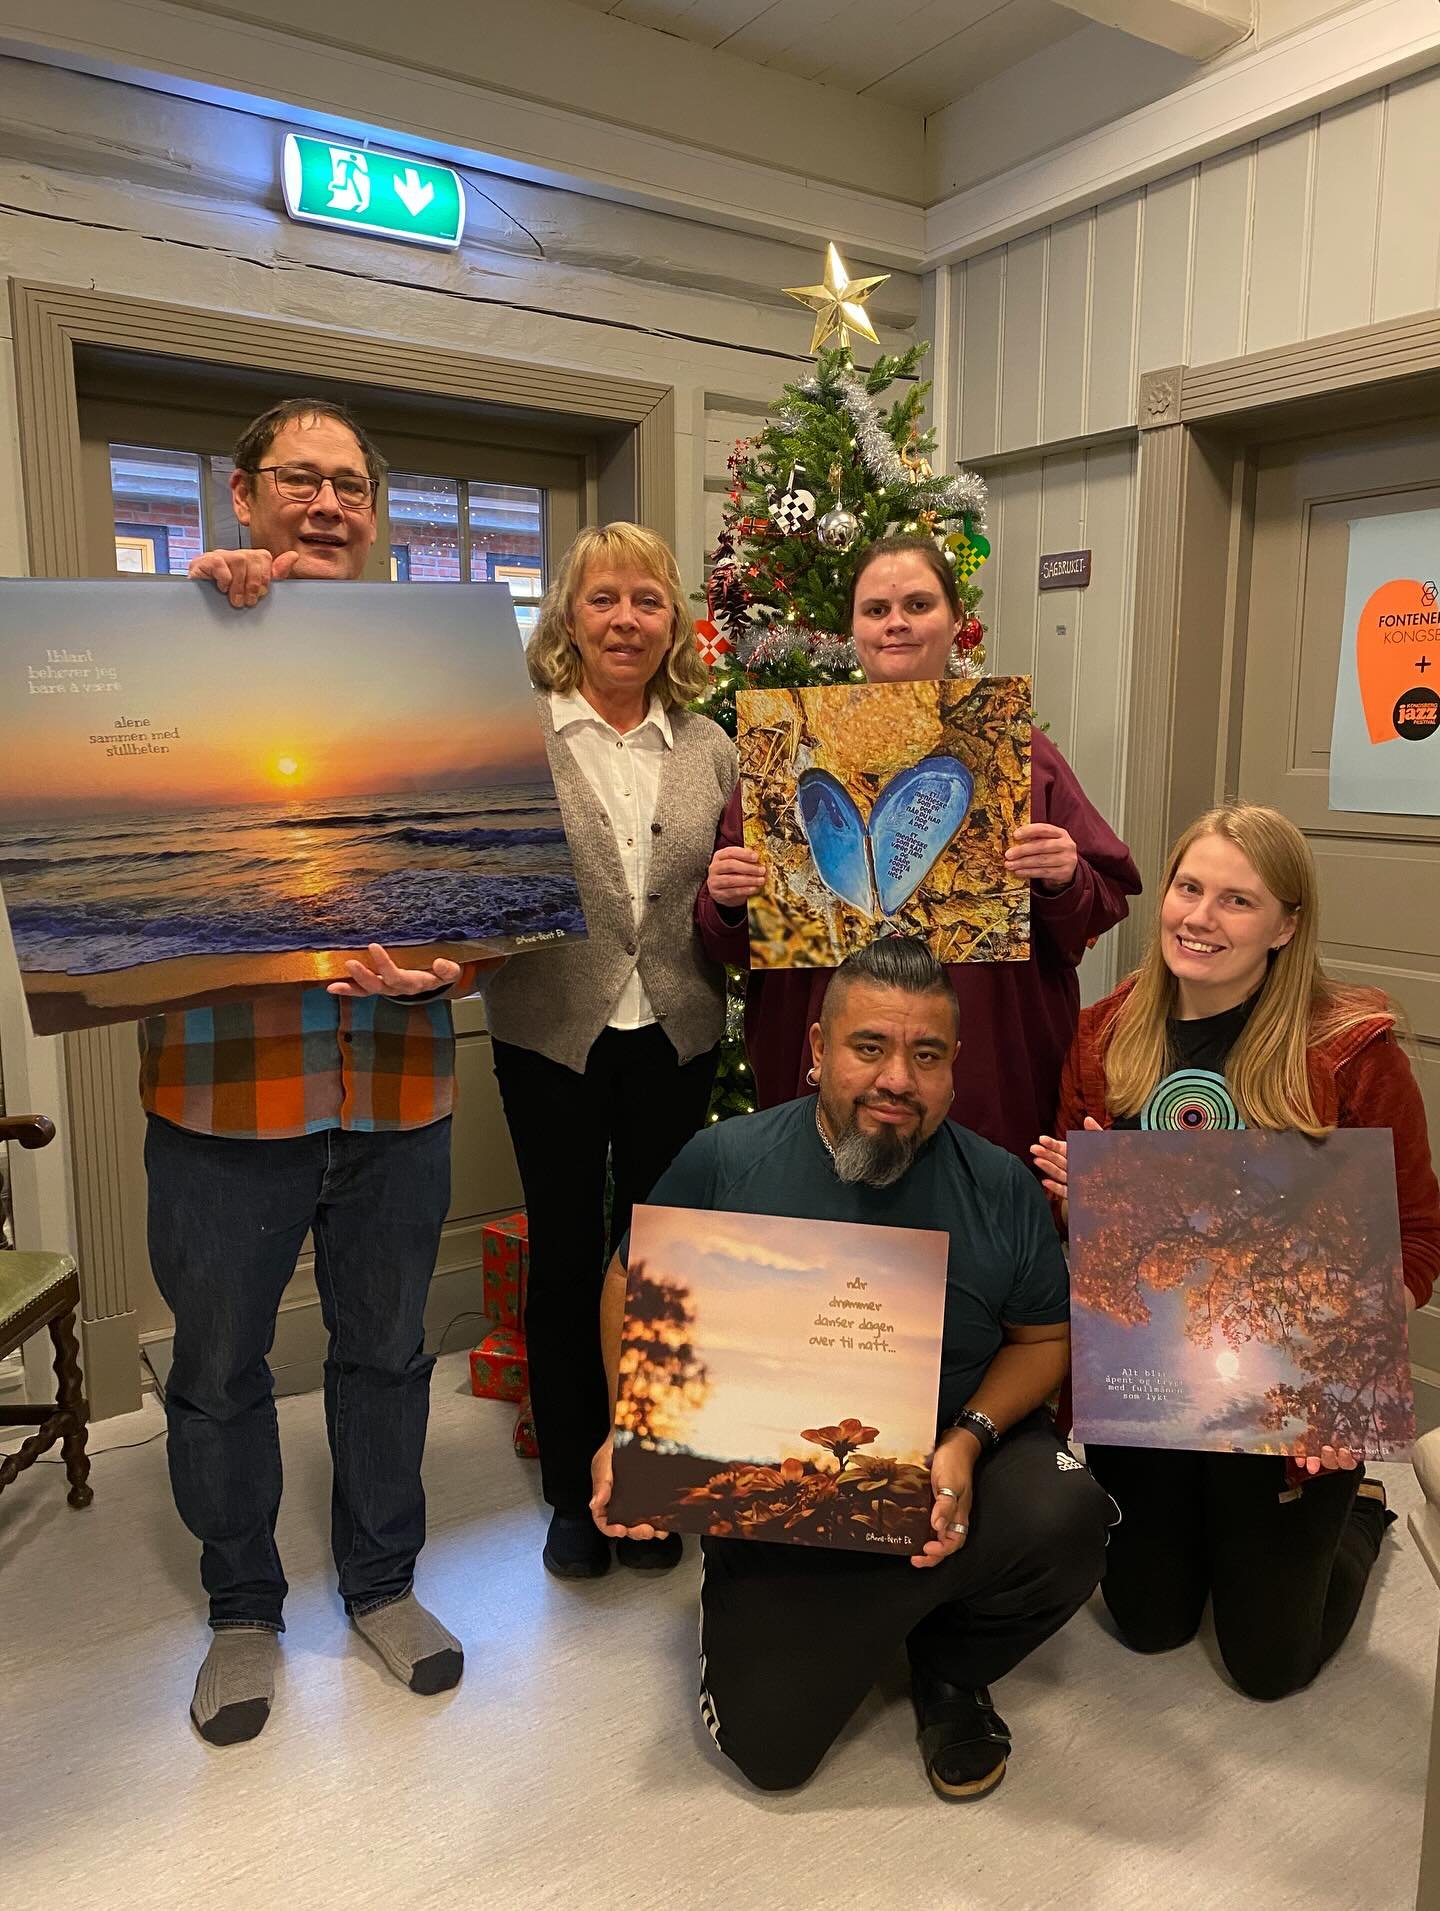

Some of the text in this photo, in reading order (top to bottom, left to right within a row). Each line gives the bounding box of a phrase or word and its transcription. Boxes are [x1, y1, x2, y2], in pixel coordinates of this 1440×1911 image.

[1379, 611, 1440, 627] FONTENE
[28, 681, 65, 694] bare
[1397, 704, 1437, 724] jazz
[114, 716, 151, 728] alene
[89, 727, 180, 744] sammen med
[106, 743, 170, 757] stillheten
[828, 1295, 883, 1312] drømmer
[814, 1313, 894, 1339] danser dagen
[808, 1336, 836, 1347] over
[839, 1335, 854, 1349] til
[1105, 1374, 1134, 1385] åpent
[1121, 1368, 1139, 1377] Alt
[1107, 1384, 1126, 1392] med
